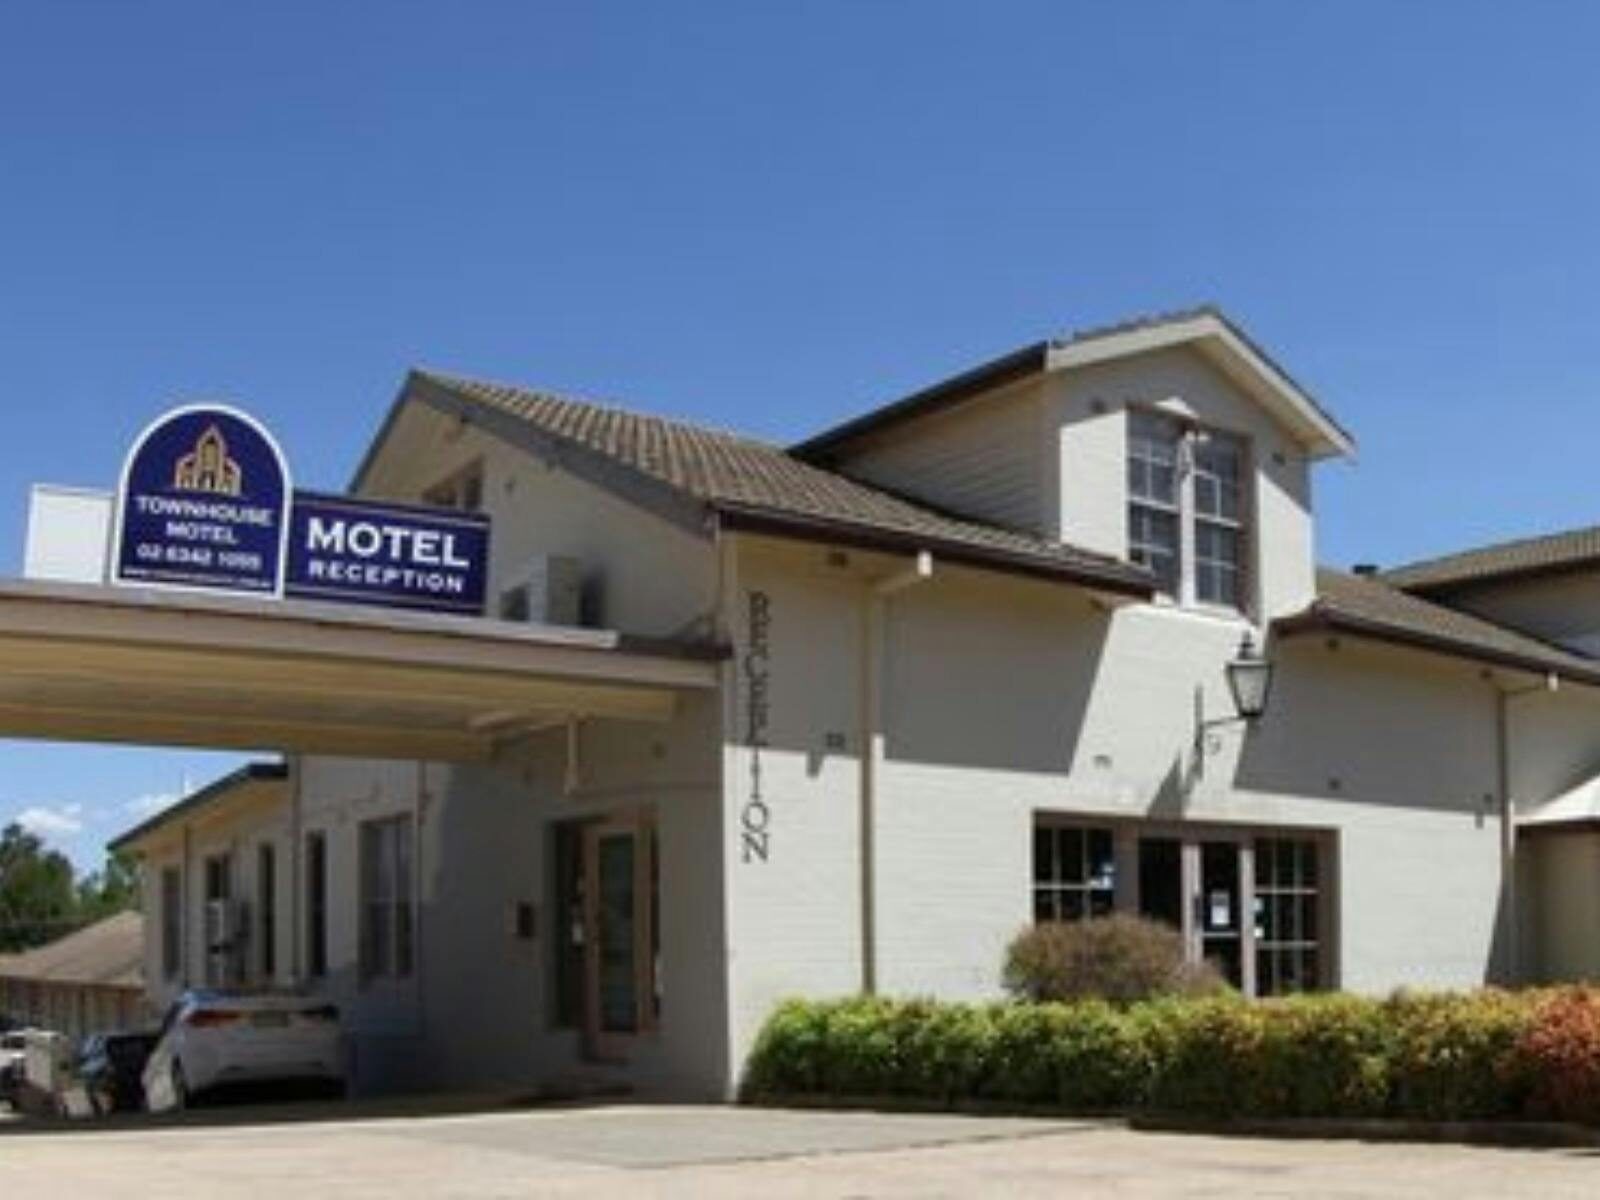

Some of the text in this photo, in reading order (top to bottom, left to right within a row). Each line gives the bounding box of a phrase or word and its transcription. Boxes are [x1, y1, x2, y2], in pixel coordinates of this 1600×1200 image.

[136, 496, 273, 525] TOWNHOUSE
[166, 520, 239, 545] MOTEL
[308, 516, 470, 568] MOTEL
[308, 559, 464, 593] RECEPTION
[741, 590, 769, 863] RECEPTION
